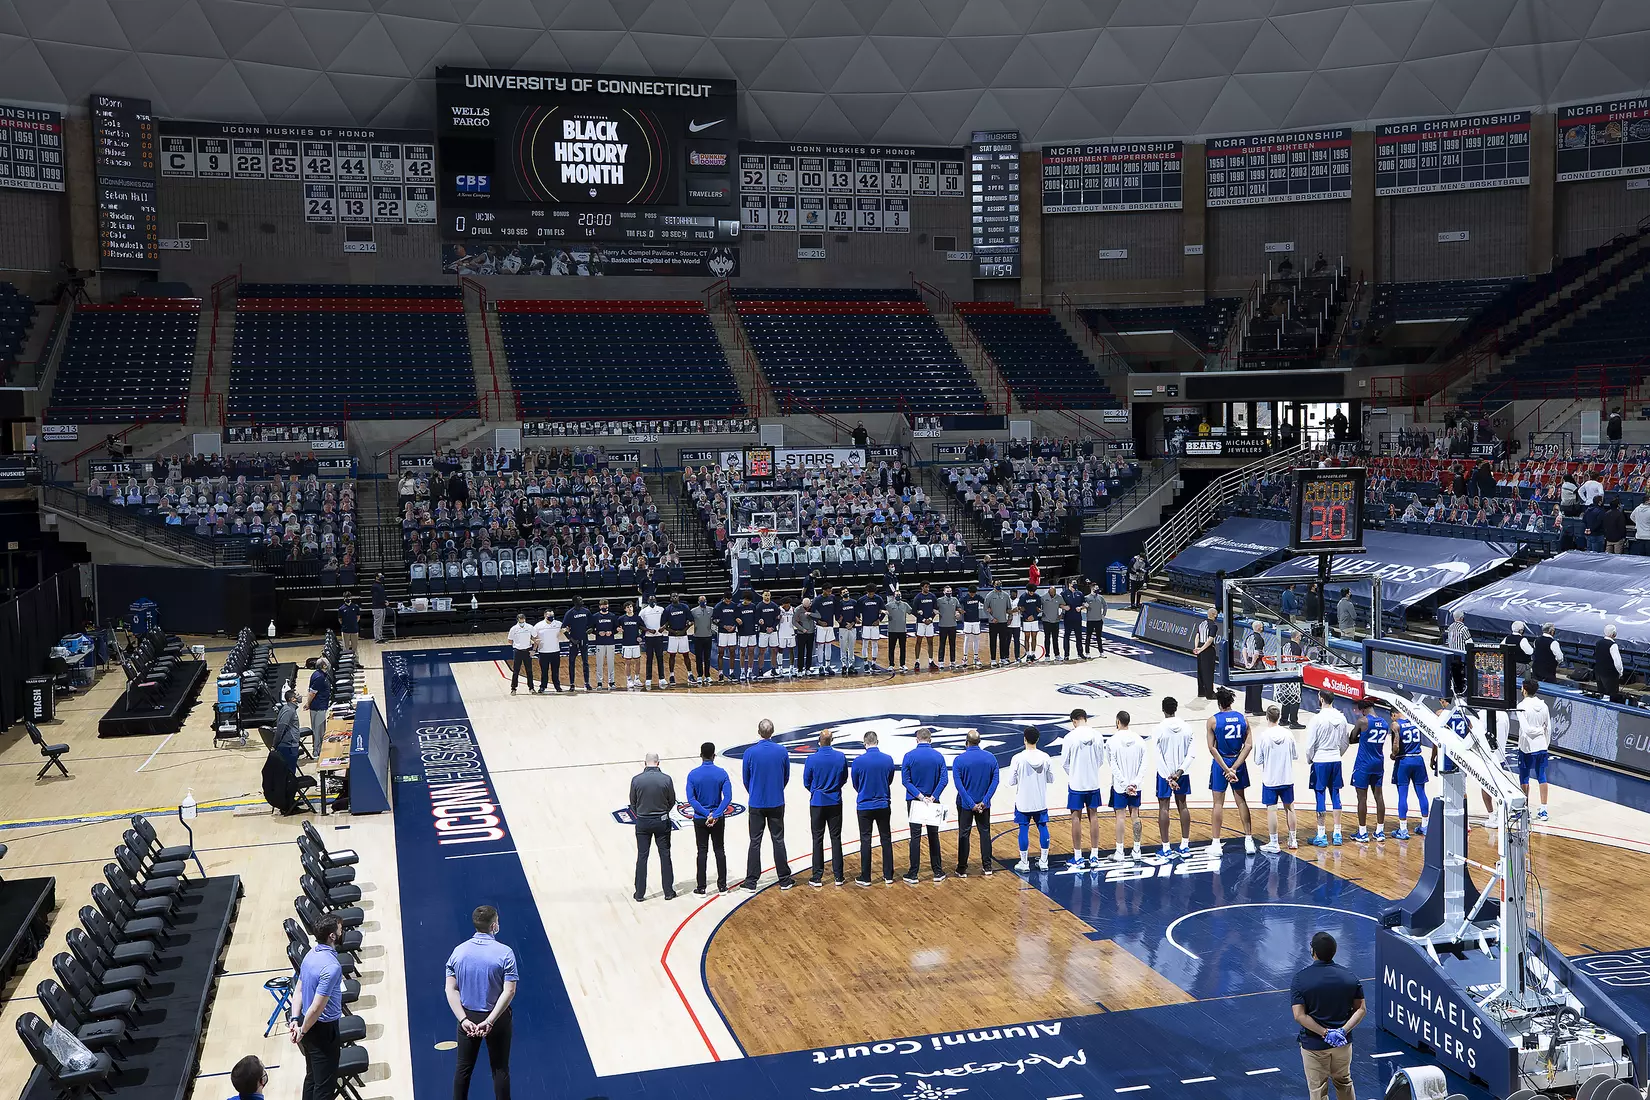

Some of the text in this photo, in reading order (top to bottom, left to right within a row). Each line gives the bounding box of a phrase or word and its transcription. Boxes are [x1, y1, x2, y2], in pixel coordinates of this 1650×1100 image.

[465, 75, 712, 97] UNIVERSITY OF CONNECTICUT
[1568, 100, 1647, 116] NCAA CHAM
[451, 107, 490, 127] WELLS FARGO
[1610, 112, 1637, 120] FINAL
[563, 120, 619, 141] BLACK
[1385, 114, 1521, 134] NCAA CHAMPIONSHIP
[1215, 131, 1342, 147] NCAA CHAMPIONSHIP
[554, 142, 628, 163] HISTORY
[1087, 144, 1174, 154] CHAMPIONSHIP
[170, 154, 185, 169] C
[209, 155, 218, 170] 9
[237, 156, 261, 171] 22
[272, 157, 296, 172] 25
[307, 159, 330, 173] 42
[341, 159, 364, 174] 44
[408, 162, 431, 176] 42
[1378, 155, 1459, 171] 2006 2009 2011 2014
[560, 163, 624, 185] MONTH
[744, 171, 763, 184] 52
[802, 173, 821, 186] 00
[832, 174, 848, 186] 13
[859, 175, 878, 187] 42
[891, 175, 902, 188] 34
[946, 177, 957, 189] 50
[1380, 185, 1436, 194] CONNECTICUT
[1470, 179, 1524, 187] BASKETBALL
[309, 200, 332, 214] 24
[345, 201, 363, 215] 13
[378, 201, 398, 216] 22
[456, 216, 466, 231] 0
[578, 213, 612, 226] 20:00
[749, 210, 759, 223] 15
[778, 210, 788, 223] 22
[864, 212, 875, 225] 13
[894, 213, 899, 225] 3
[730, 221, 738, 236] 0
[985, 265, 1012, 276] 11:59
[774, 454, 834, 465] -STARS
[1306, 482, 1352, 502] 20:00
[1311, 506, 1345, 540] 30
[1479, 588, 1607, 619] Mohegan
[33, 689, 42, 718] TRASH
[1225, 725, 1242, 738] 21
[1451, 721, 1465, 735] 14
[1367, 730, 1386, 743] 22
[1402, 729, 1420, 743] 33
[416, 725, 484, 782] HUSKIES
[428, 781, 505, 844] UCONN
[1384, 964, 1482, 1039] MICHAELS
[1388, 1001, 1476, 1069] JEWELERS
[812, 1022, 1062, 1064] Alumni Court
[905, 1049, 1087, 1077] Mohegan
